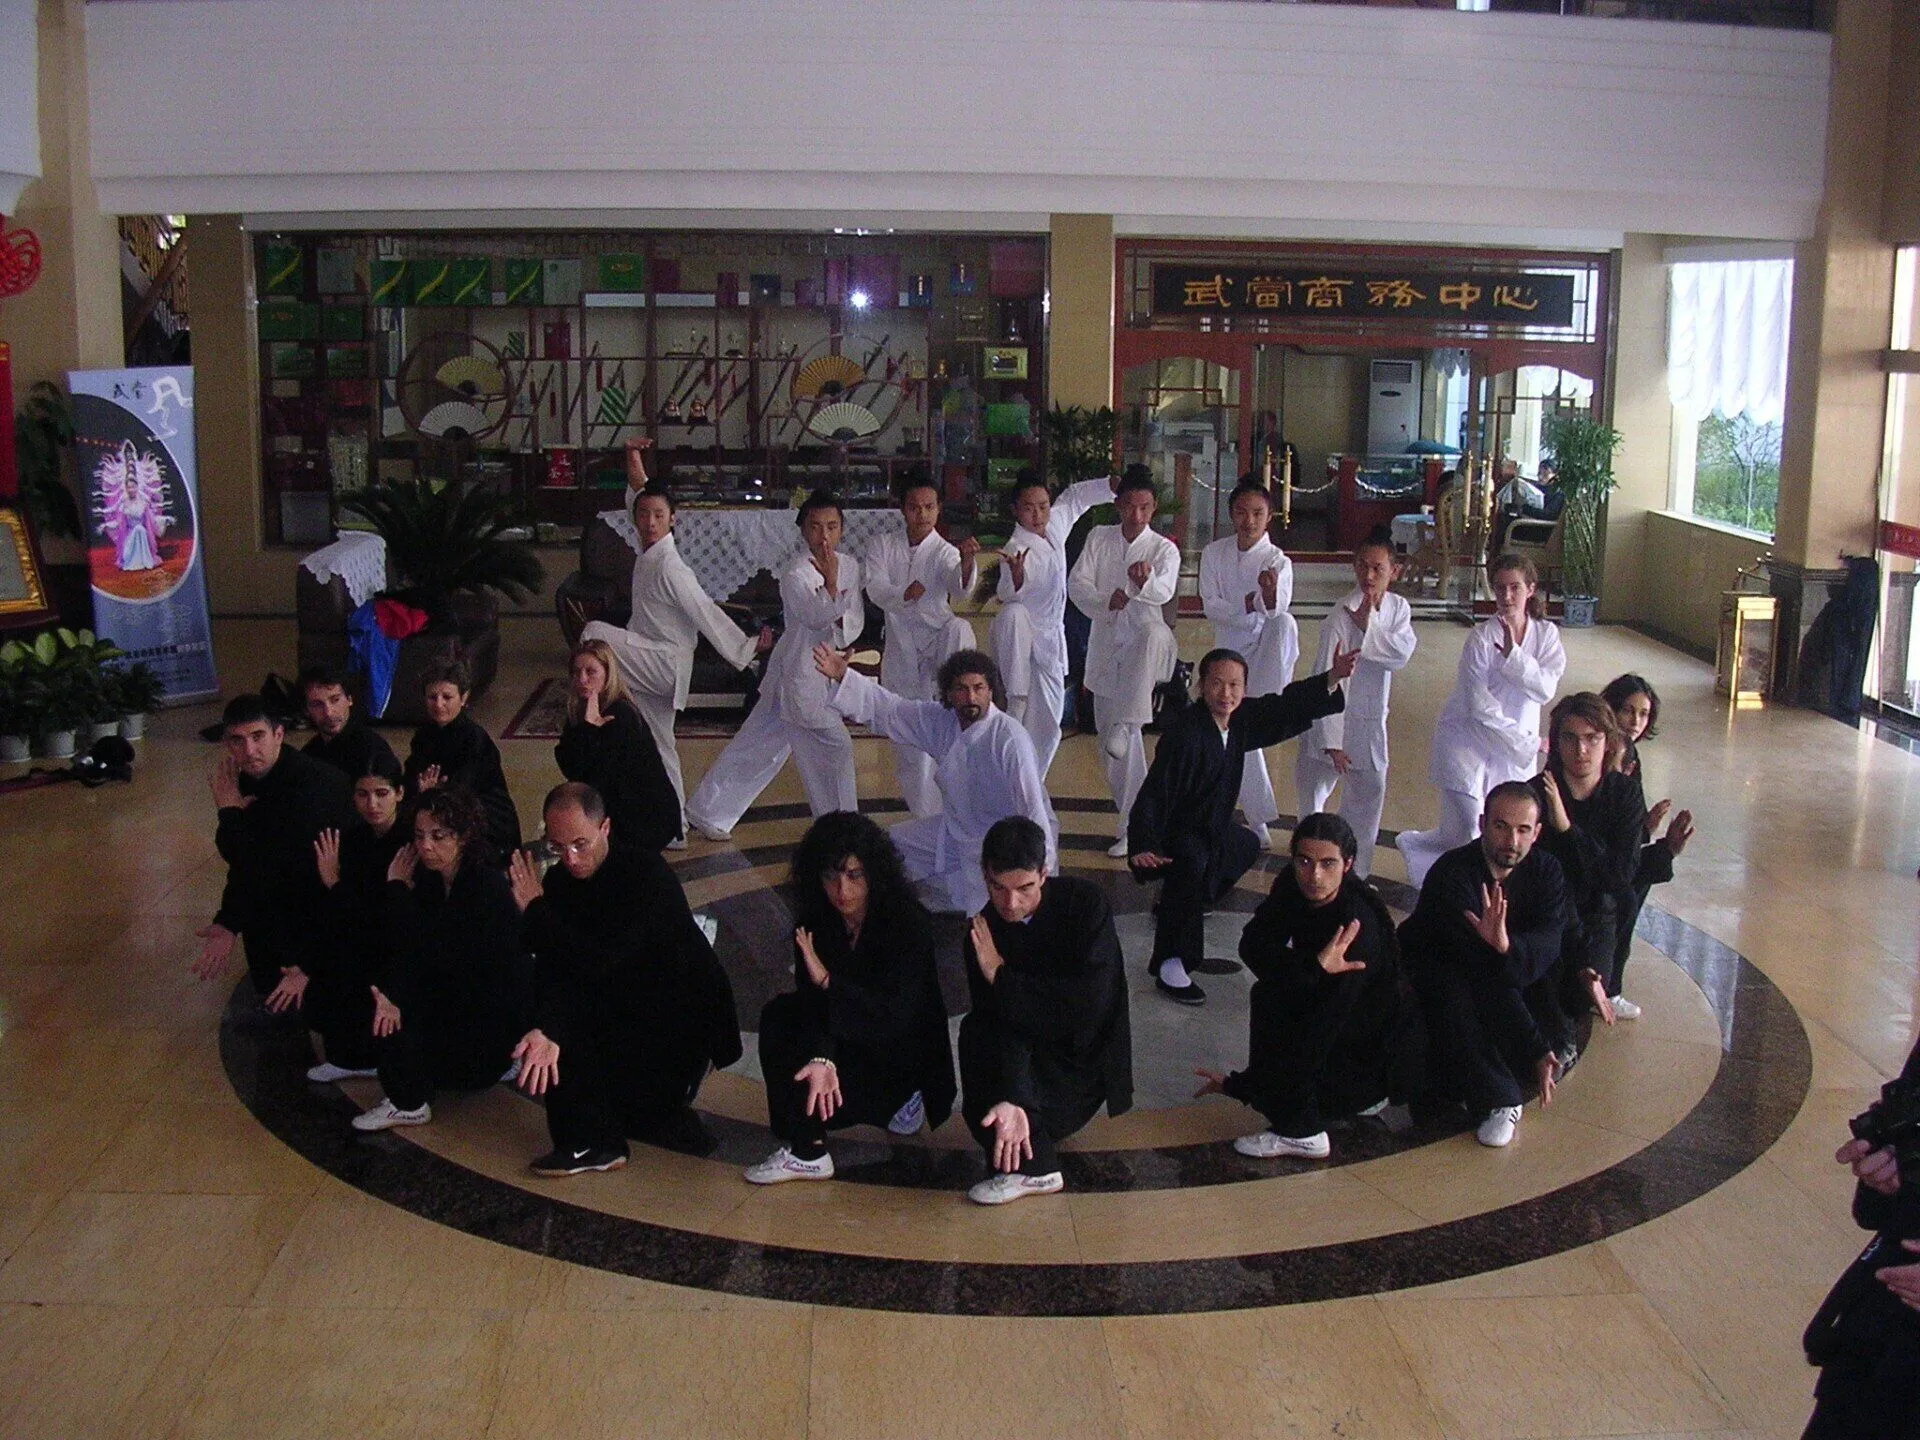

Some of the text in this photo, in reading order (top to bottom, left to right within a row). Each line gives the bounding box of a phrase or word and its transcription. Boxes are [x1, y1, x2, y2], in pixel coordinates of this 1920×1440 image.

[1184, 275, 1538, 310] 武當商務中心
